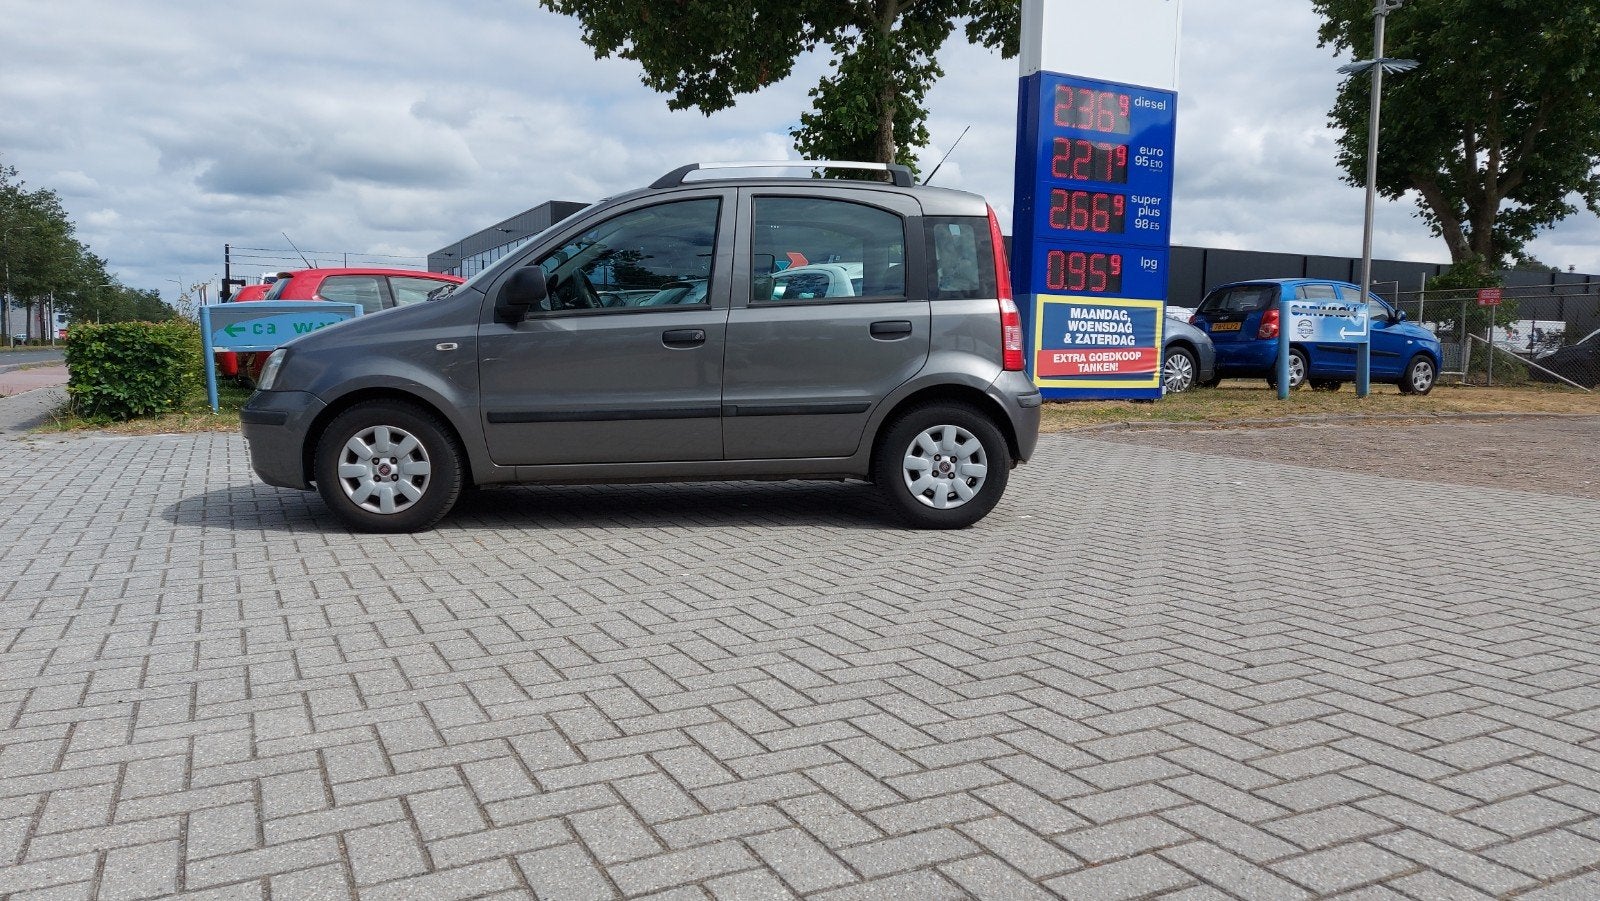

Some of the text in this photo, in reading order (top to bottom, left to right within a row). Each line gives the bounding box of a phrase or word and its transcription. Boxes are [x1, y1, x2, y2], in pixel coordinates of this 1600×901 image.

[1134, 97, 1166, 111] diesel
[1140, 146, 1164, 157] euro
[1134, 155, 1163, 169] 95 E10
[1131, 194, 1161, 206] super
[1138, 206, 1161, 217] plus
[1134, 218, 1160, 230] 98 E5
[1140, 256, 1158, 270] lpg
[1070, 308, 1131, 322] MAANDAG,
[1068, 320, 1133, 333] WOENSDAG
[1063, 332, 1136, 345] & ZATERDAG
[1053, 351, 1142, 363] EXTRA GOEDKOOP
[1078, 362, 1119, 372] TANKEN!
